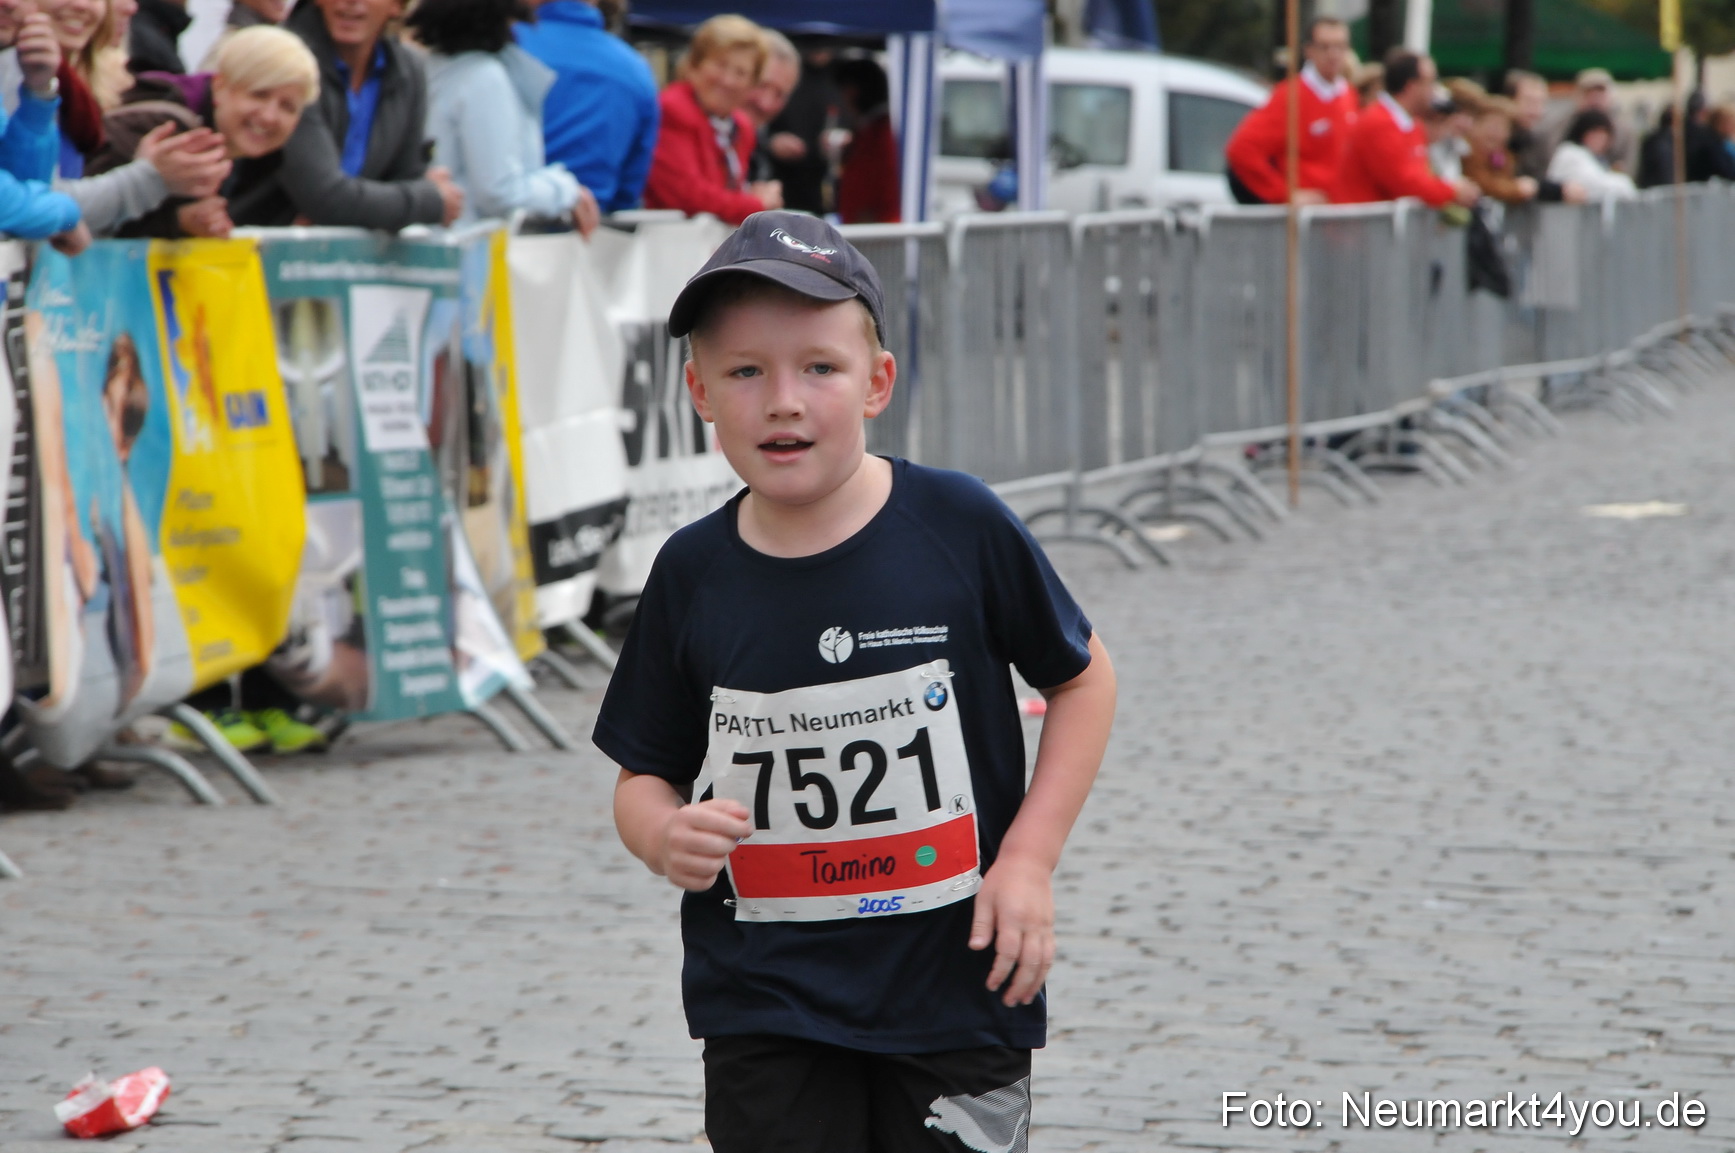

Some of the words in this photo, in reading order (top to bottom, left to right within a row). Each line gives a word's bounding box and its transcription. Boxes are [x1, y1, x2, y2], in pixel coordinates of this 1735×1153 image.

[791, 697, 915, 733] Neumarkt
[732, 726, 942, 831] 7521
[954, 798, 964, 811] K
[800, 850, 896, 884] Tamino
[858, 897, 905, 914] 2005
